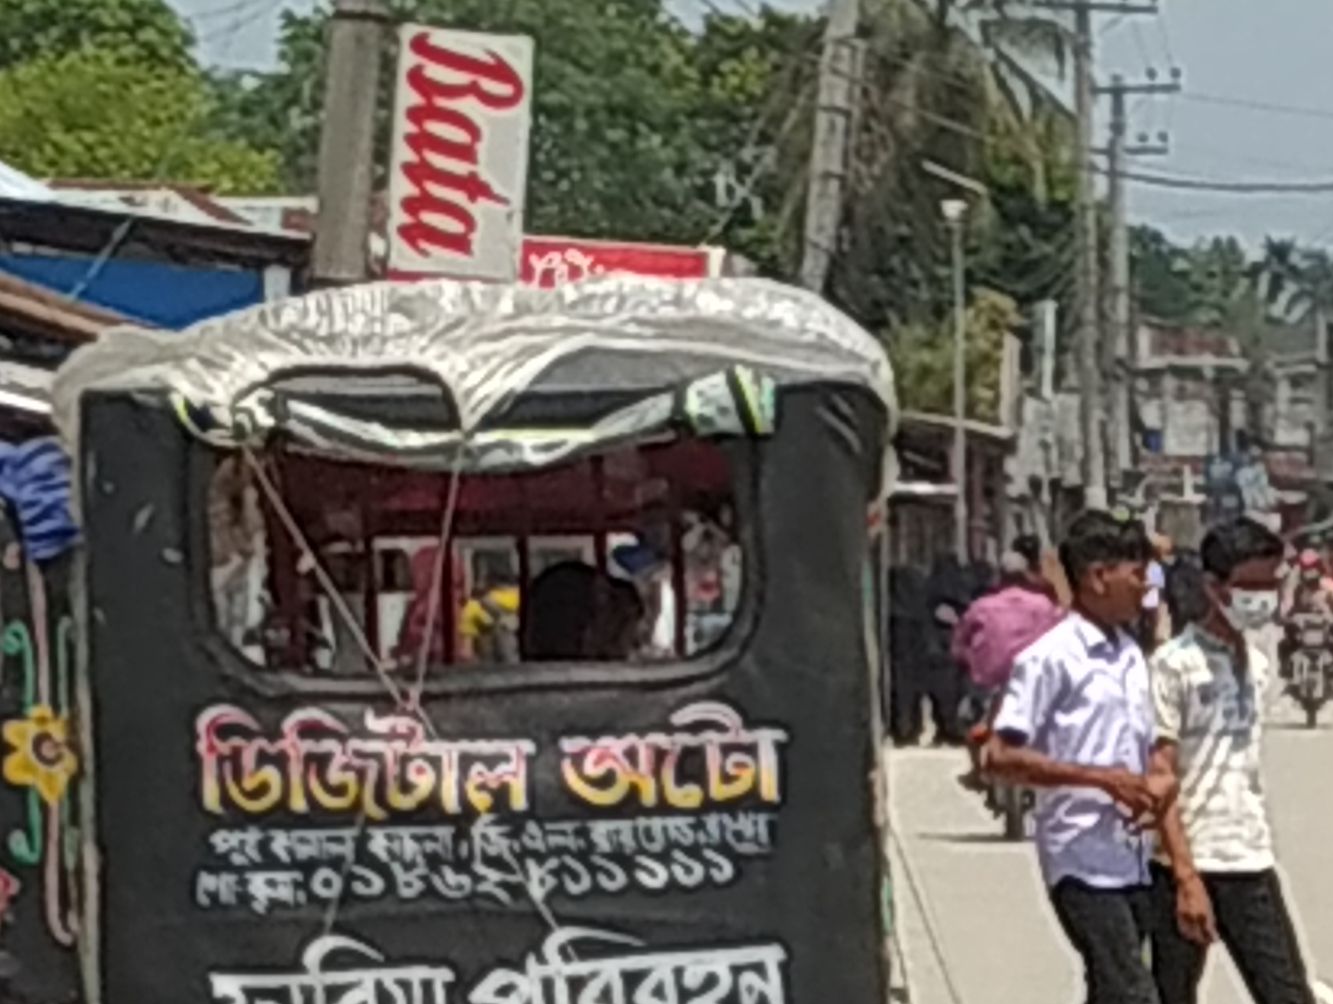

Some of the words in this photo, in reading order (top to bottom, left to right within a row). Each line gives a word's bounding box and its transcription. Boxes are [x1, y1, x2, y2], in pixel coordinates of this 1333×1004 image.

[397, 31, 524, 258] Bata
[197, 704, 536, 818] ডিজিটাল
[560, 702, 788, 810] অটো
